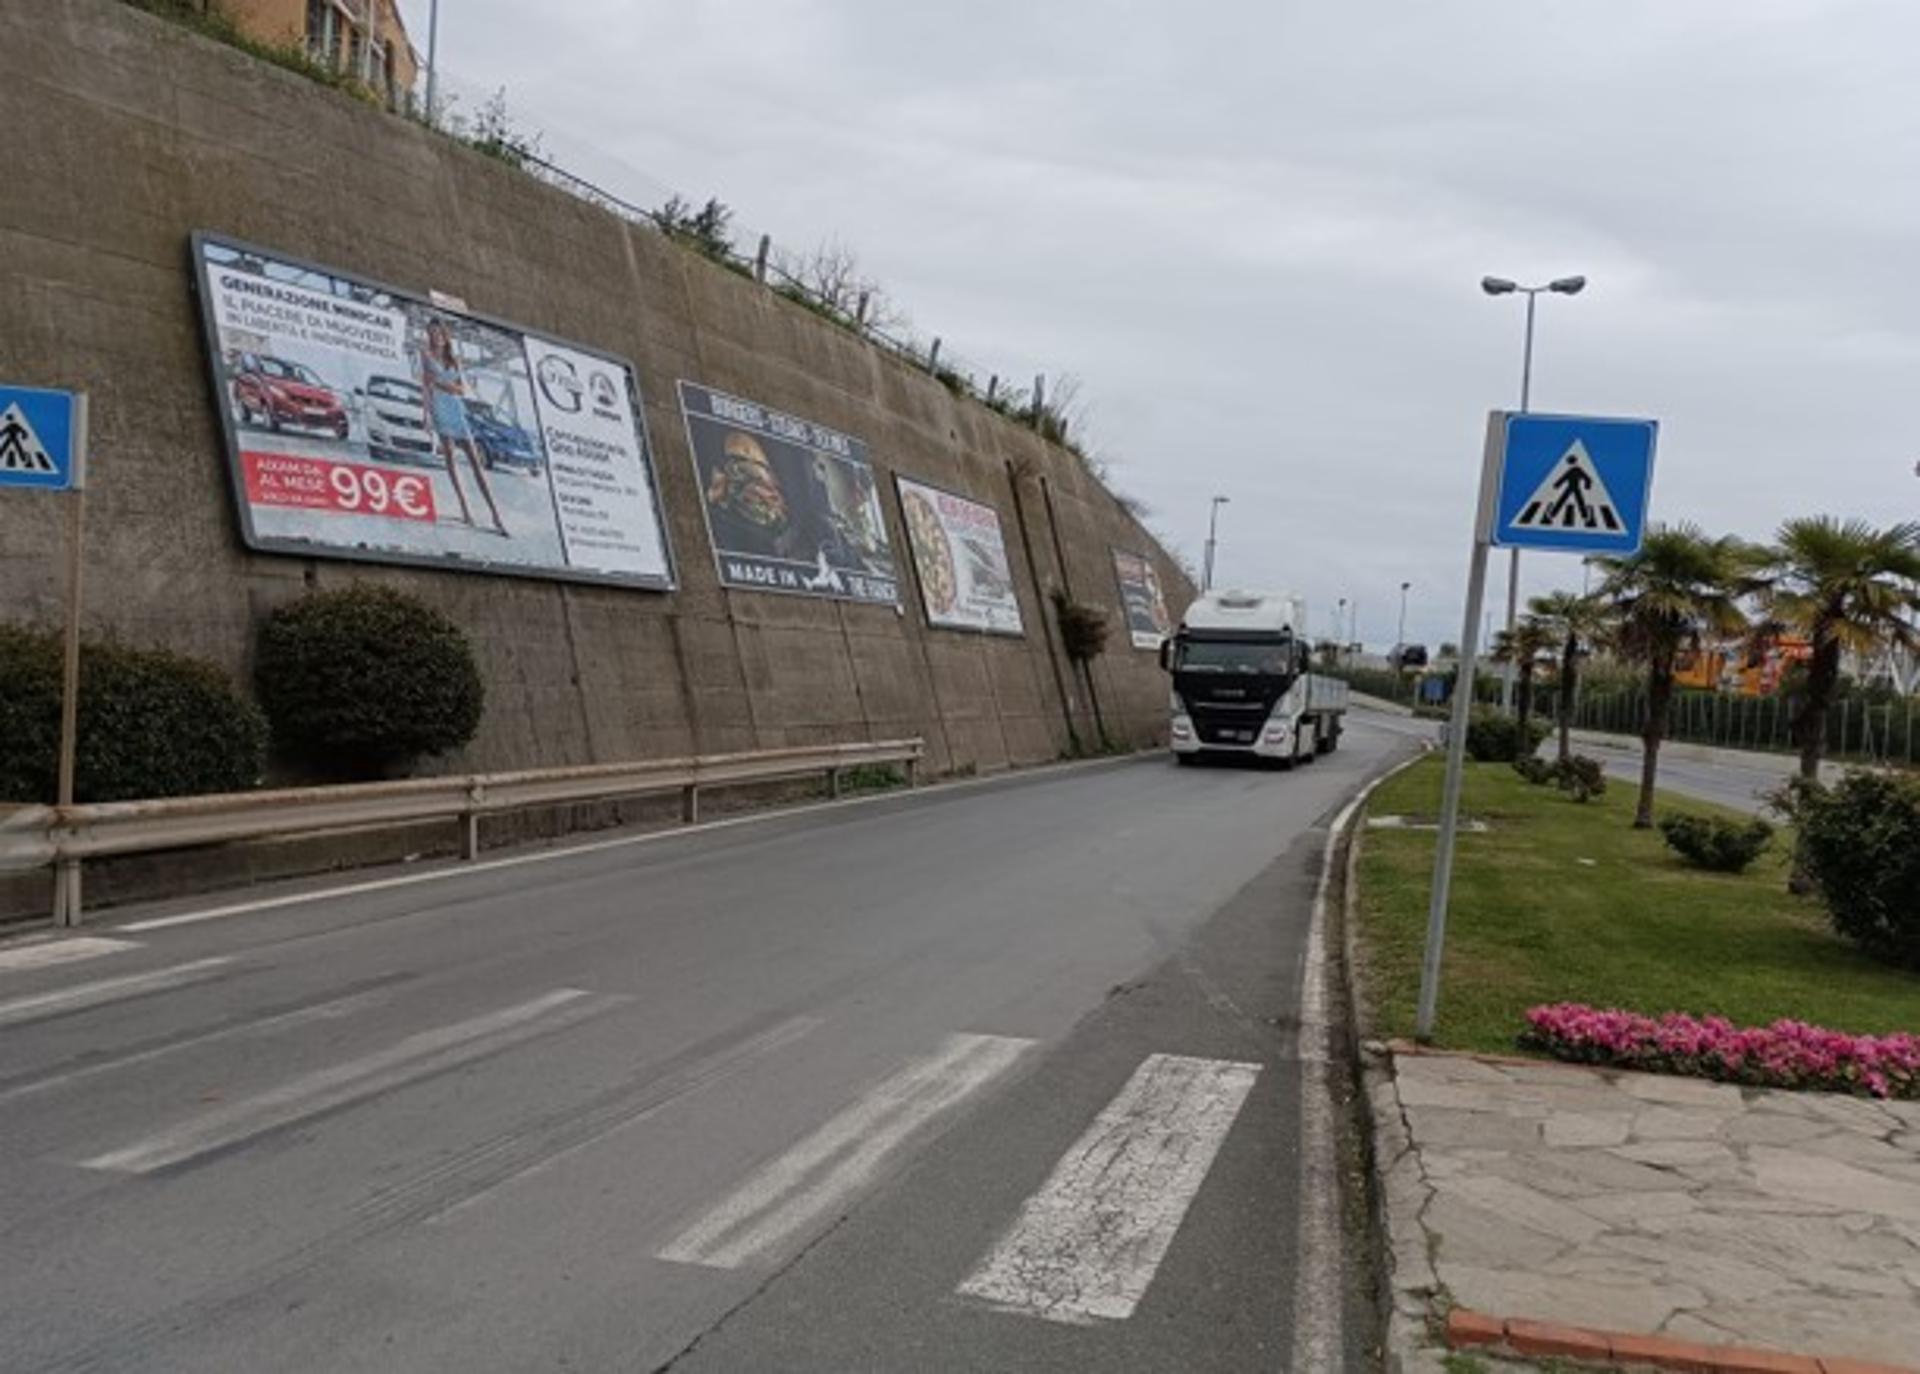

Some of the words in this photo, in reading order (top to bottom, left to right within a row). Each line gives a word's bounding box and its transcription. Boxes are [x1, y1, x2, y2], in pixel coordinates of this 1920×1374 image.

[220, 275, 331, 313] GENERAZIONE
[330, 466, 428, 516] 99€
[728, 563, 778, 585] MADE
